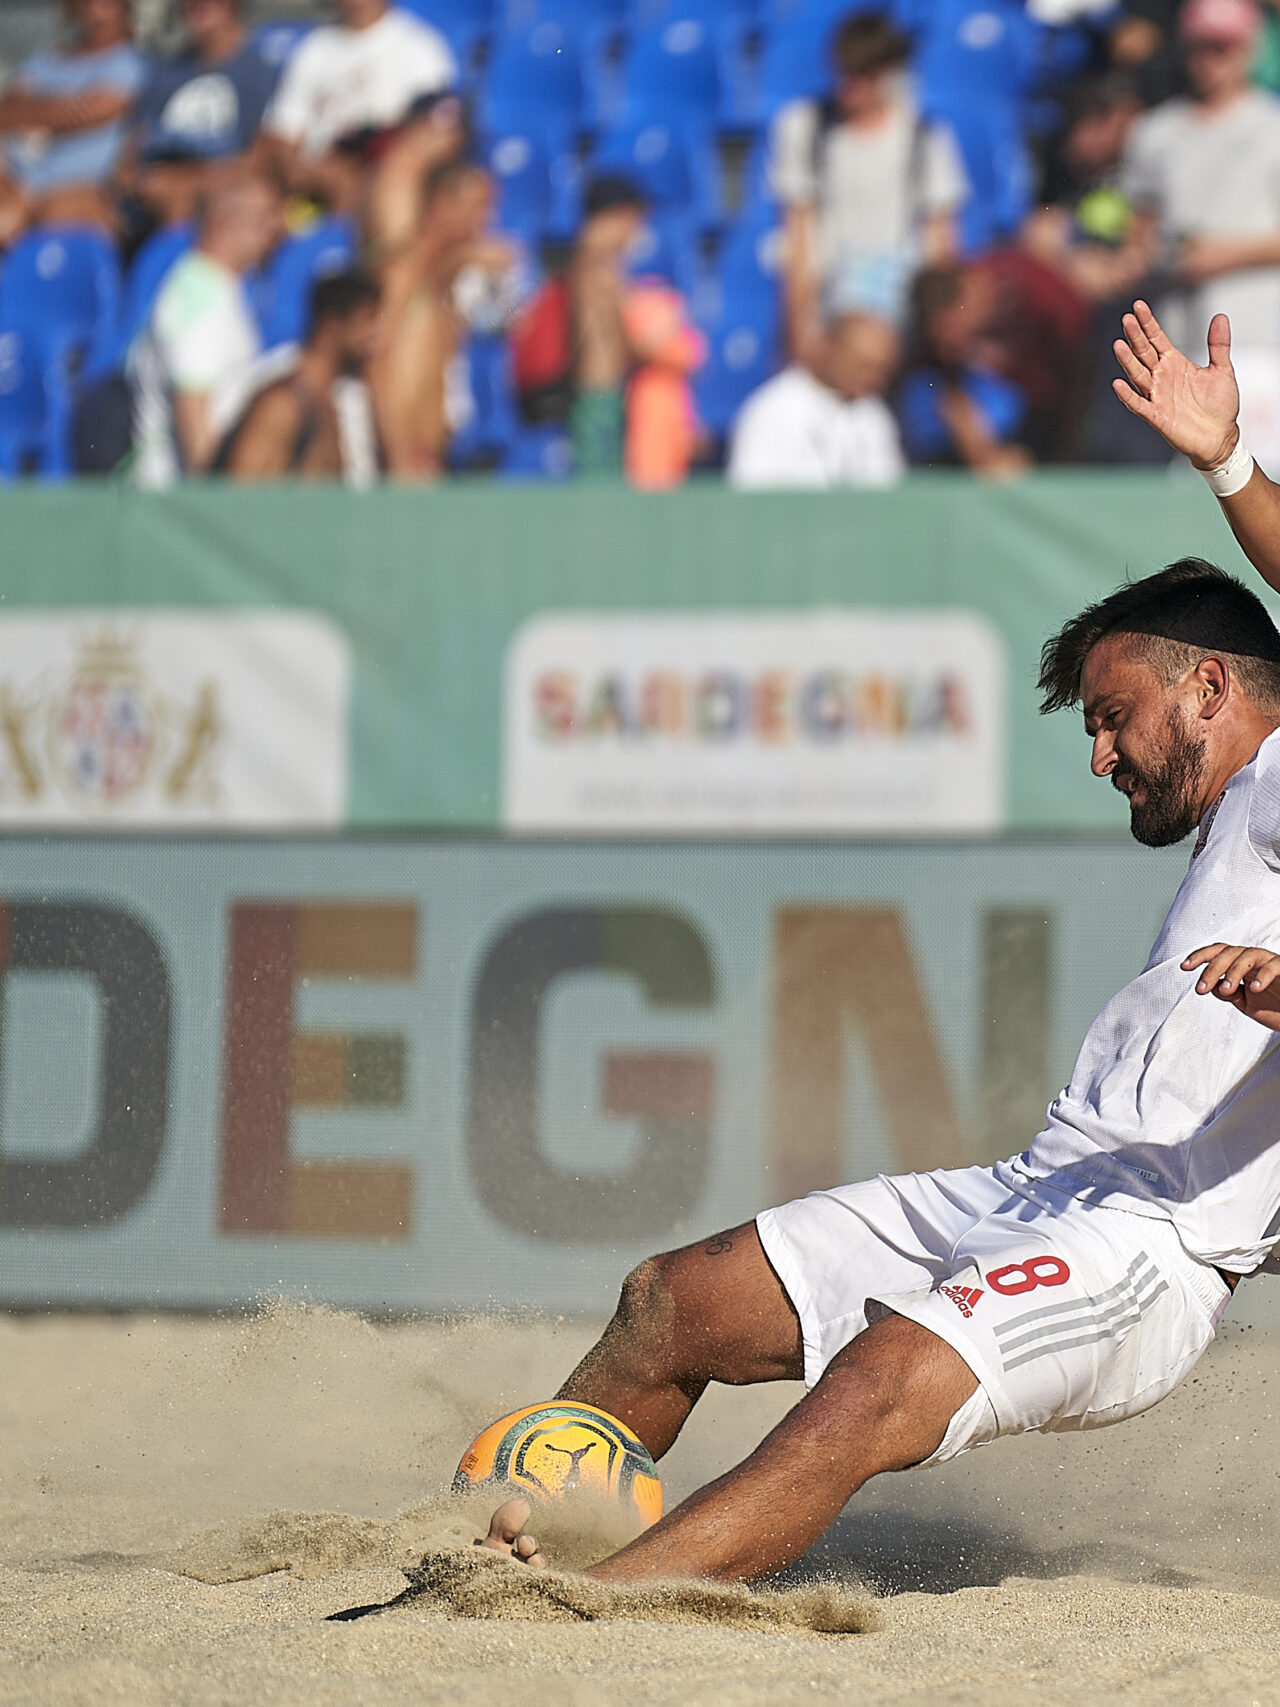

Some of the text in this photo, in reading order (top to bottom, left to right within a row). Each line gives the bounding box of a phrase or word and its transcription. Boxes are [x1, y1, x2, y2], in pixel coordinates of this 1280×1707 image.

[533, 666, 977, 744] SARDEGNA
[986, 1255, 1070, 1296] 8
[940, 1286, 973, 1318] adidas
